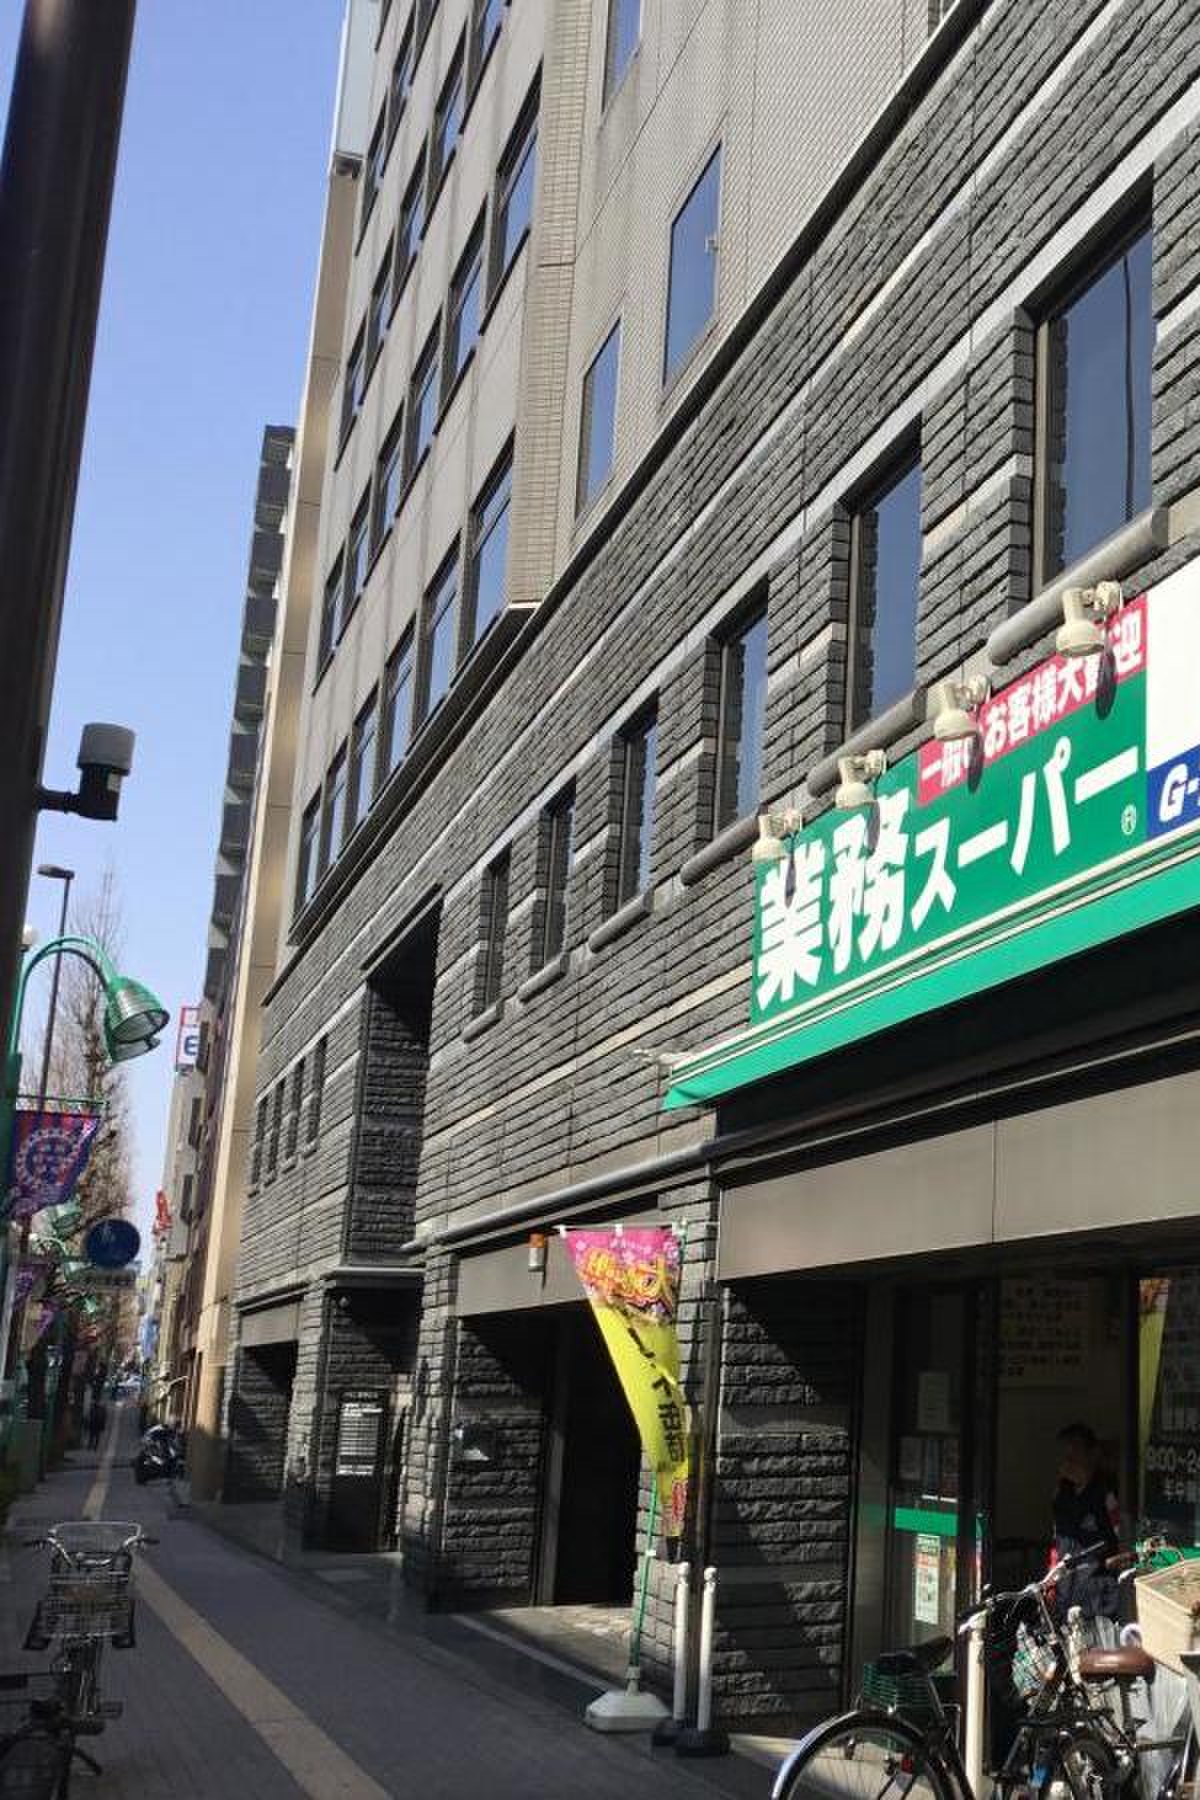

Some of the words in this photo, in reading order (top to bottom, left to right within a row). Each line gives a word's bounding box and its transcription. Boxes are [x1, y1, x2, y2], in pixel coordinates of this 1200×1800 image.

[756, 736, 1139, 1010] 業務スーパー
